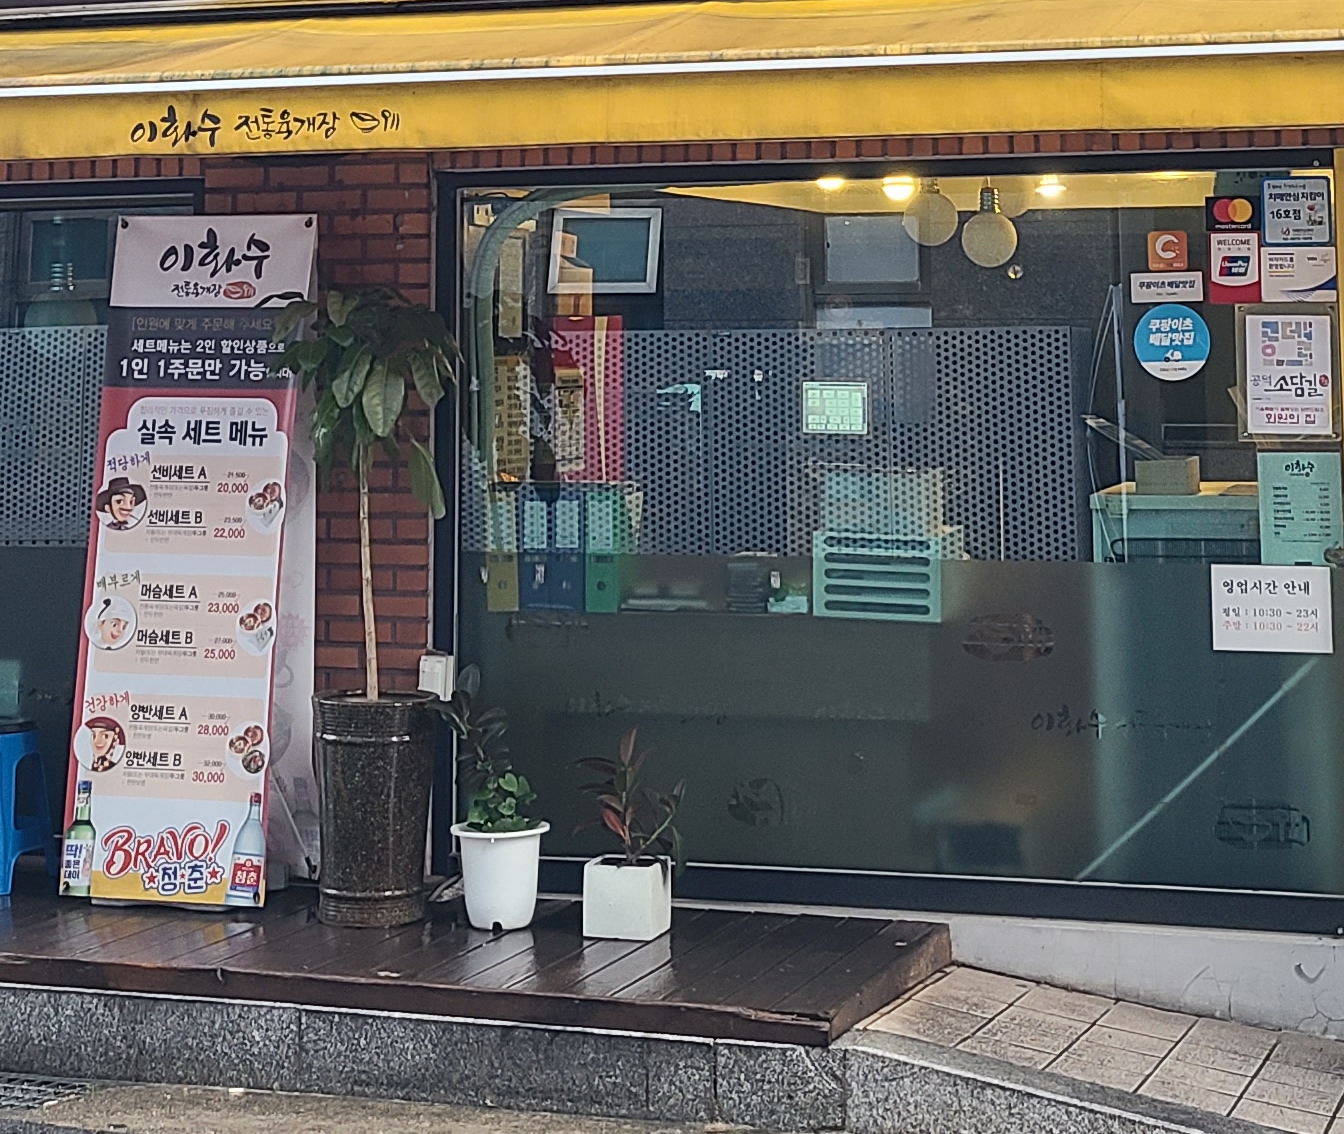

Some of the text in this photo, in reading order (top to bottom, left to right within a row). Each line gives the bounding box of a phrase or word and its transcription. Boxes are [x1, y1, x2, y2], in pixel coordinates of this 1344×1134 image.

[130, 104, 341, 148] 이화수 전통육개장
[1269, 208, 1301, 220] 16호점
[1216, 238, 1251, 246] WELCOME
[158, 227, 271, 280] 이화수
[174, 317, 197, 332] 맞게
[201, 317, 235, 332] 주문해
[239, 318, 274, 331] 주세요
[1148, 317, 1194, 332] 쿠팡이츠
[131, 339, 286, 354] 세트메뉴는 2인 할인상품으로
[1149, 332, 1195, 346] 배달맛집
[120, 358, 149, 379] 1인
[157, 358, 223, 380] 1주문만
[137, 418, 268, 447] 실속 세트 메뉴
[106, 450, 151, 473] 적당하게
[150, 464, 195, 481] 선비세트
[197, 465, 208, 480] A
[216, 482, 249, 494] 20,000
[146, 509, 192, 525] 선비세트
[194, 511, 203, 525] B
[213, 527, 246, 539] 22,000
[96, 569, 141, 592] 배부르게
[1222, 579, 1310, 596] 영업시간 안내
[140, 583, 186, 600] 머슴세트
[187, 585, 198, 599] A
[207, 602, 240, 614] 23,000
[1253, 607, 1282, 618] 10:30
[1296, 608, 1318, 619] 23시
[1253, 621, 1283, 631] 10:30
[1296, 621, 1319, 633] 22시
[136, 629, 182, 645] 머슴세트
[184, 631, 194, 645] B
[203, 648, 236, 660] 25,000
[85, 690, 130, 714] 건강하게
[130, 704, 176, 721] 양반세트
[178, 706, 189, 721] A
[197, 724, 229, 736] 28,000
[125, 750, 170, 767] 양반세트
[172, 753, 182, 767] B
[191, 771, 225, 783] 30,000
[102, 821, 229, 876] BRAVO!
